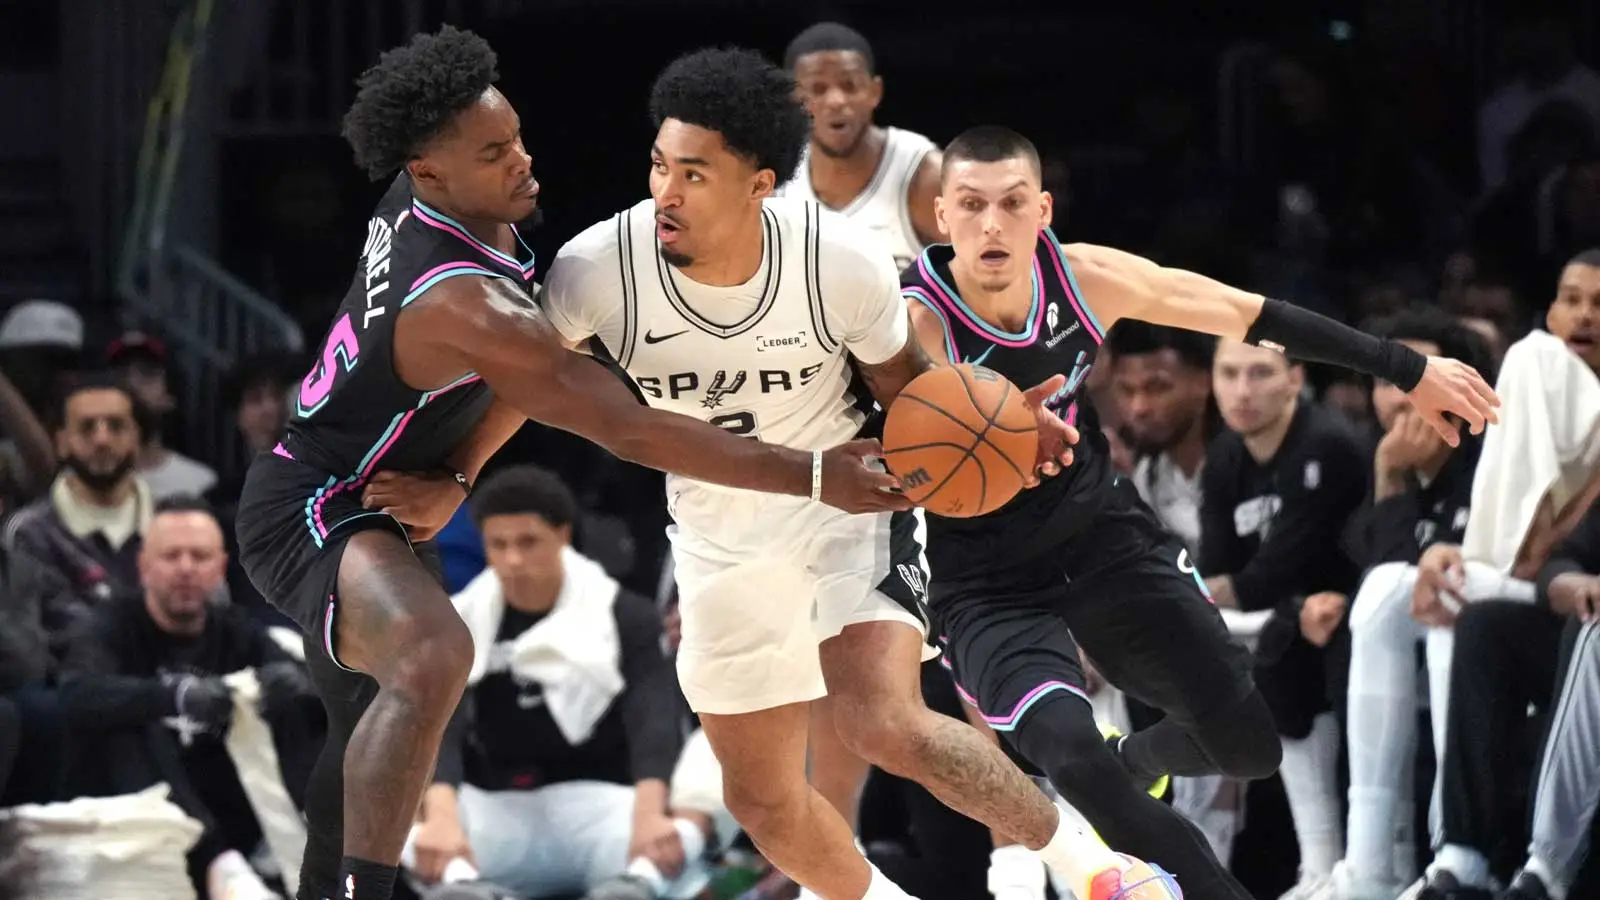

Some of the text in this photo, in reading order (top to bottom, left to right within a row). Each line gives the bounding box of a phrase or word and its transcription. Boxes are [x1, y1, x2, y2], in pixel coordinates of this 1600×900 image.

[762, 336, 801, 348] LEDGER
[1045, 320, 1080, 349] Robinhood
[297, 312, 360, 418] 5
[636, 362, 823, 409] SPURS
